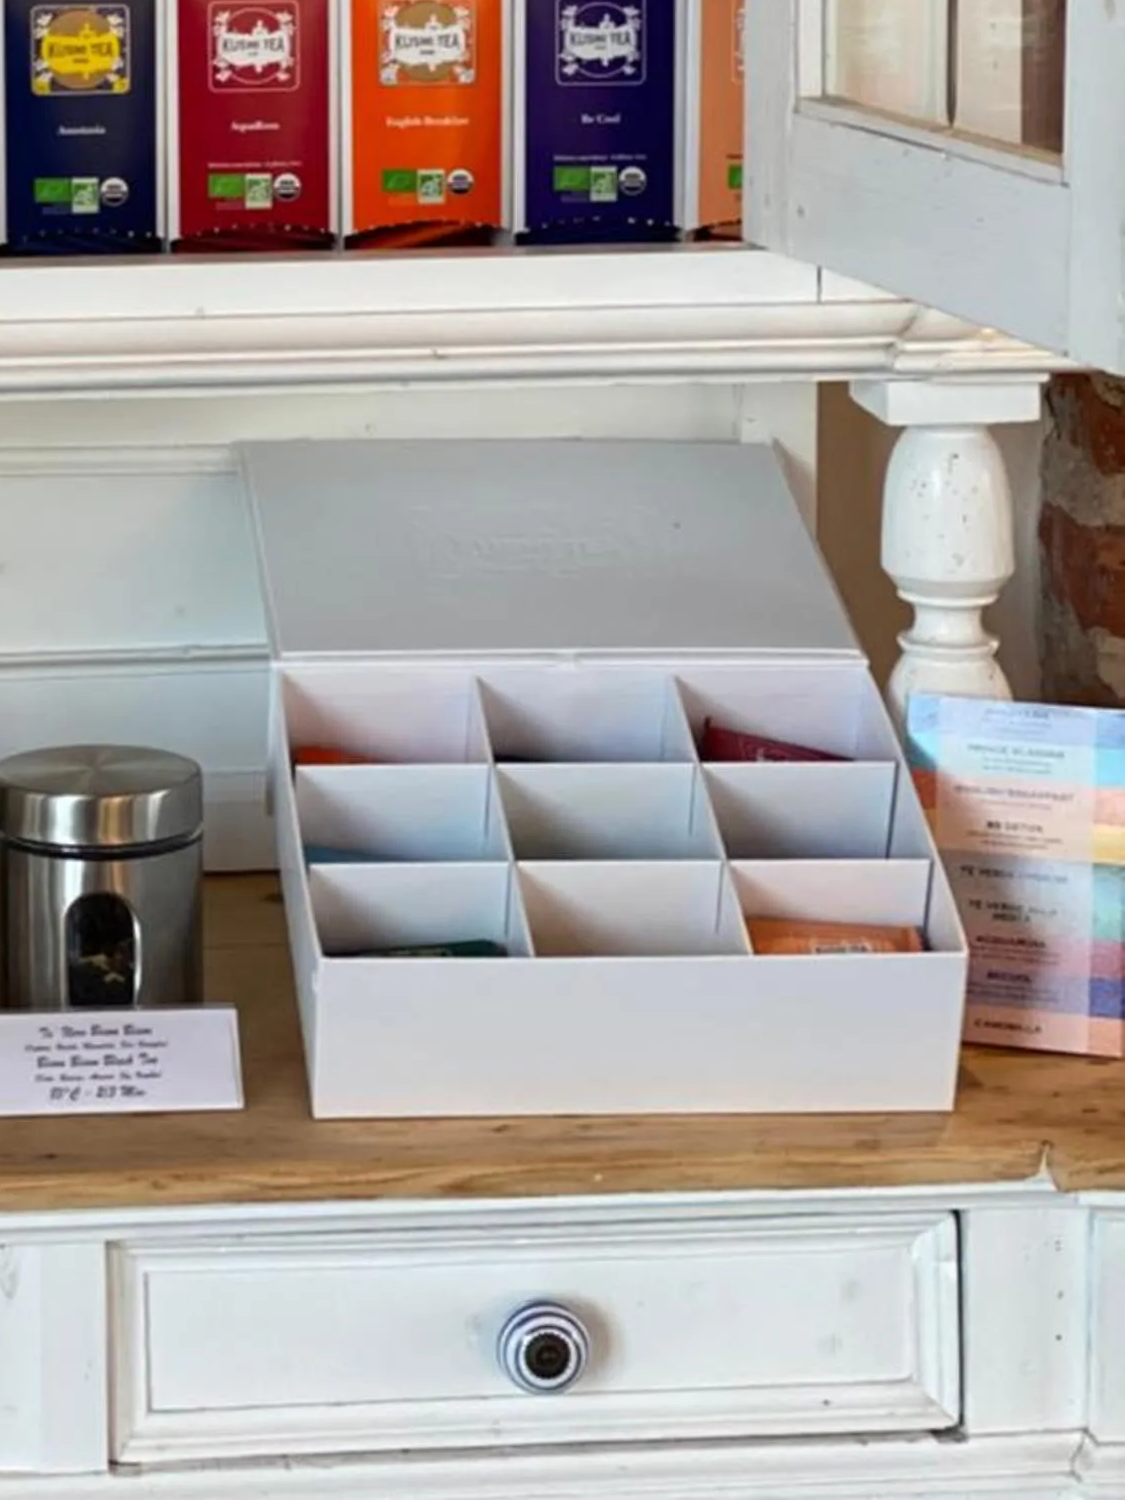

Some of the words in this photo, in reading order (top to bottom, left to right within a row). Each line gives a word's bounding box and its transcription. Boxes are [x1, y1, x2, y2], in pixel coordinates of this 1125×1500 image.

[222, 37, 260, 53] KUSMI
[263, 37, 285, 52] TEA
[394, 34, 434, 50] KUSMI
[438, 33, 460, 49] TEA
[610, 31, 632, 45] TEA
[385, 115, 422, 129] English
[424, 115, 470, 127] Breakfast
[580, 113, 594, 124] Be
[596, 113, 621, 124] Cool
